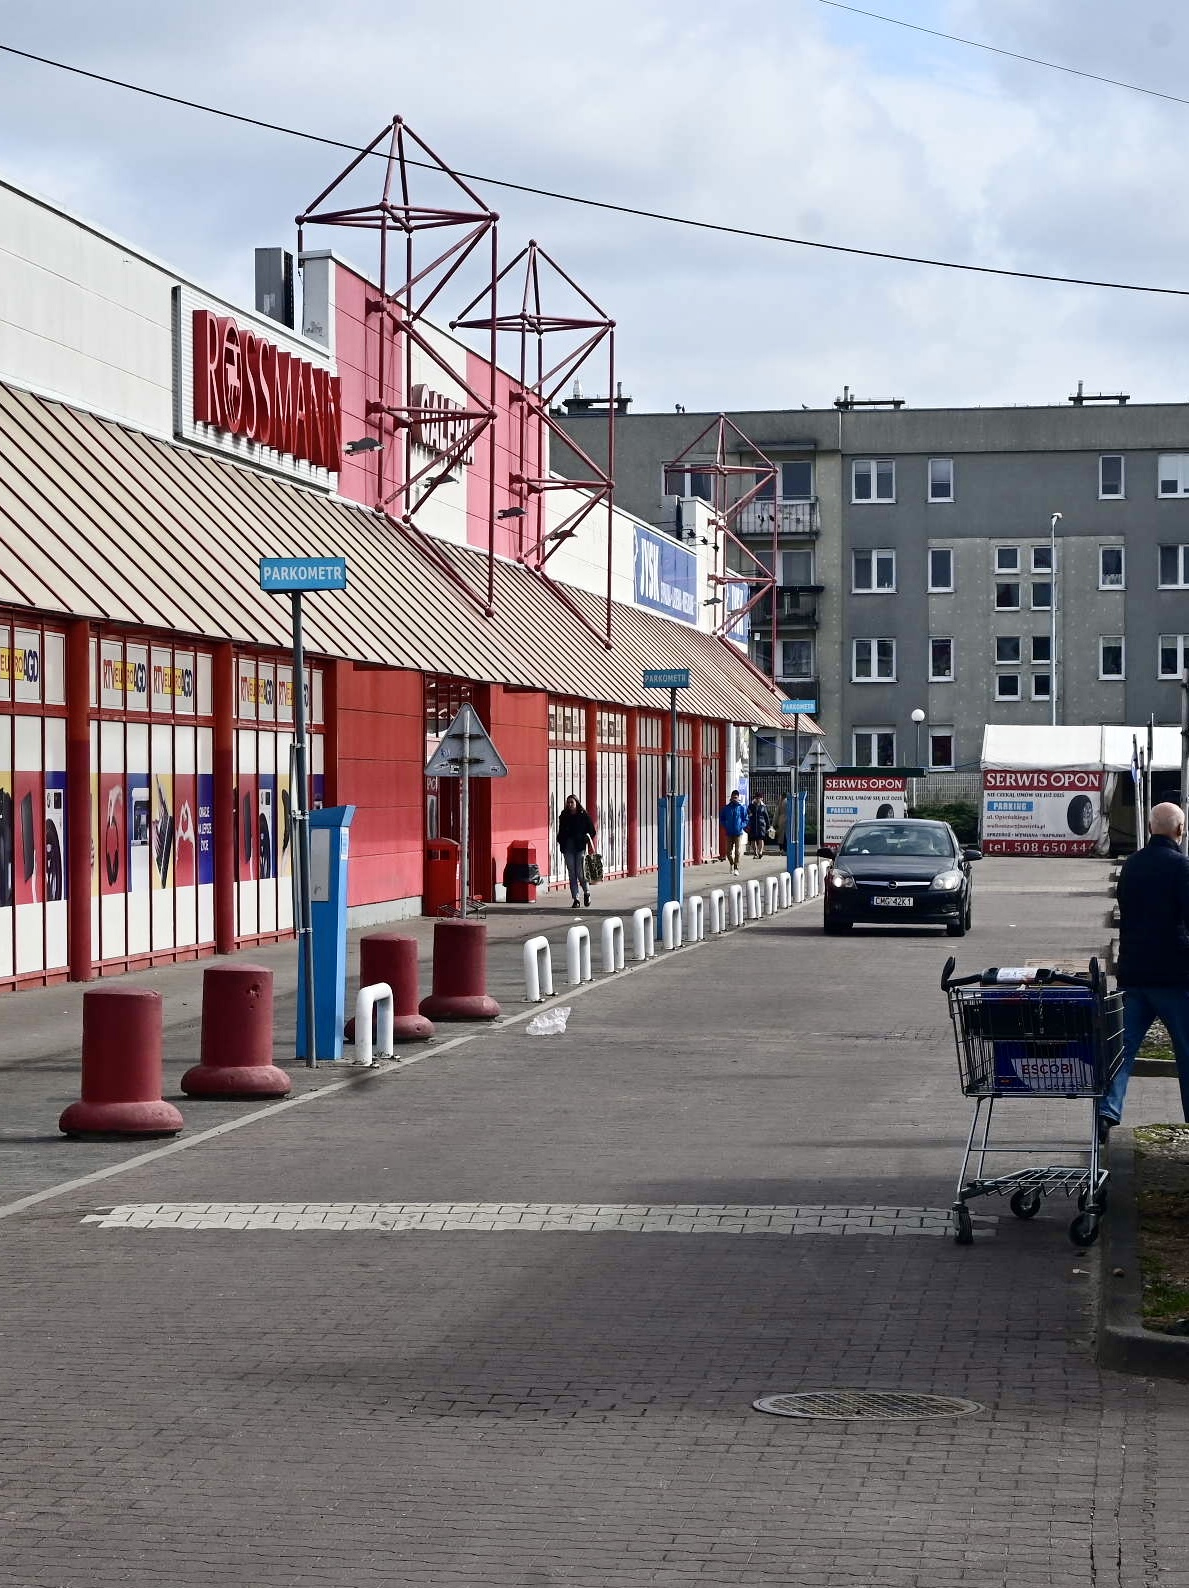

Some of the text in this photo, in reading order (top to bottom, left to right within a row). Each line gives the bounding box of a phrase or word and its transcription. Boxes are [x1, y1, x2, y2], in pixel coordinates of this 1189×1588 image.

[193, 309, 342, 473] ROSSMANN
[263, 566, 343, 581] PARKOMETR
[23, 648, 39, 682] AGD
[825, 779, 903, 789] SERWIS OPON
[986, 772, 1100, 787] SERWIS OPON
[993, 802, 1027, 811] PARKING
[989, 842, 1010, 852] tel.
[1014, 842, 1039, 852] 508
[1042, 842, 1067, 852] 650
